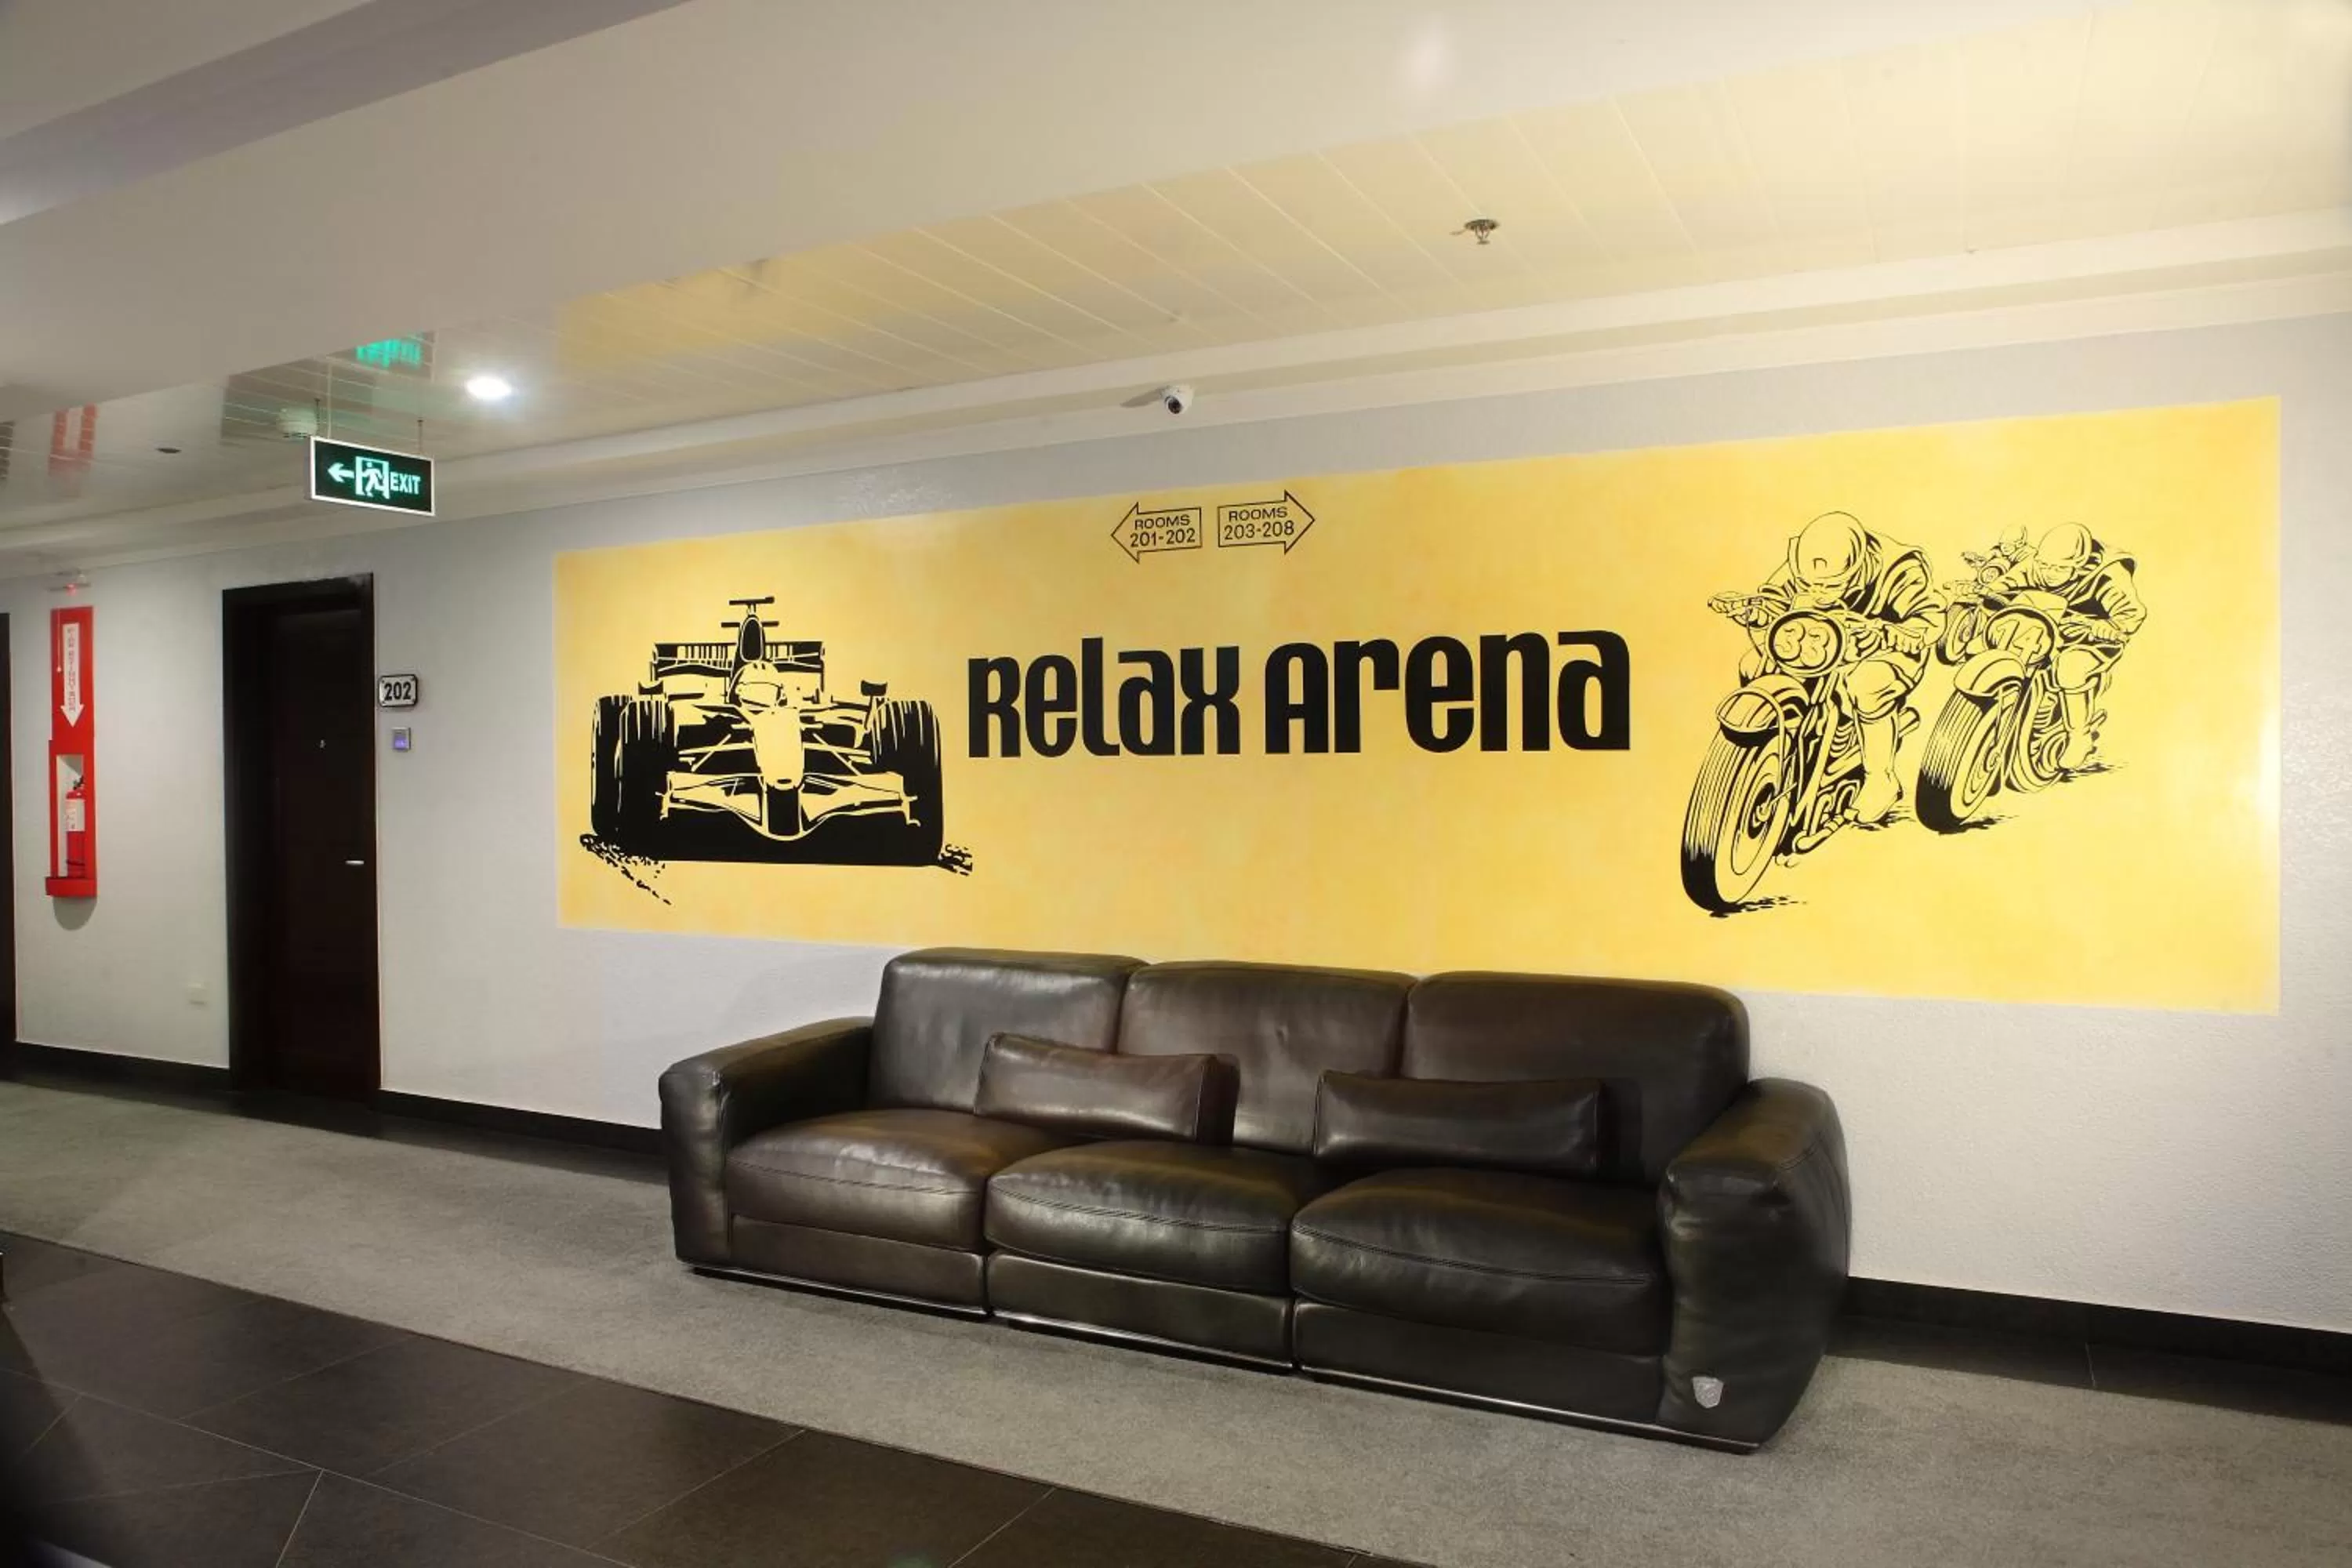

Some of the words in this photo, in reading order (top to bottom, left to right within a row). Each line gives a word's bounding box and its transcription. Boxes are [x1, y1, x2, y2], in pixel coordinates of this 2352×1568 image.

[390, 471, 421, 495] EXIT
[1134, 514, 1191, 531] ROOMS
[1229, 506, 1288, 523] ROOMS
[1130, 527, 1196, 548] 201-202
[1224, 519, 1294, 540] 203-208
[1774, 620, 1830, 670] 33
[383, 681, 412, 701] 202
[968, 637, 1240, 758] Relax
[1265, 630, 1630, 754] Arena
